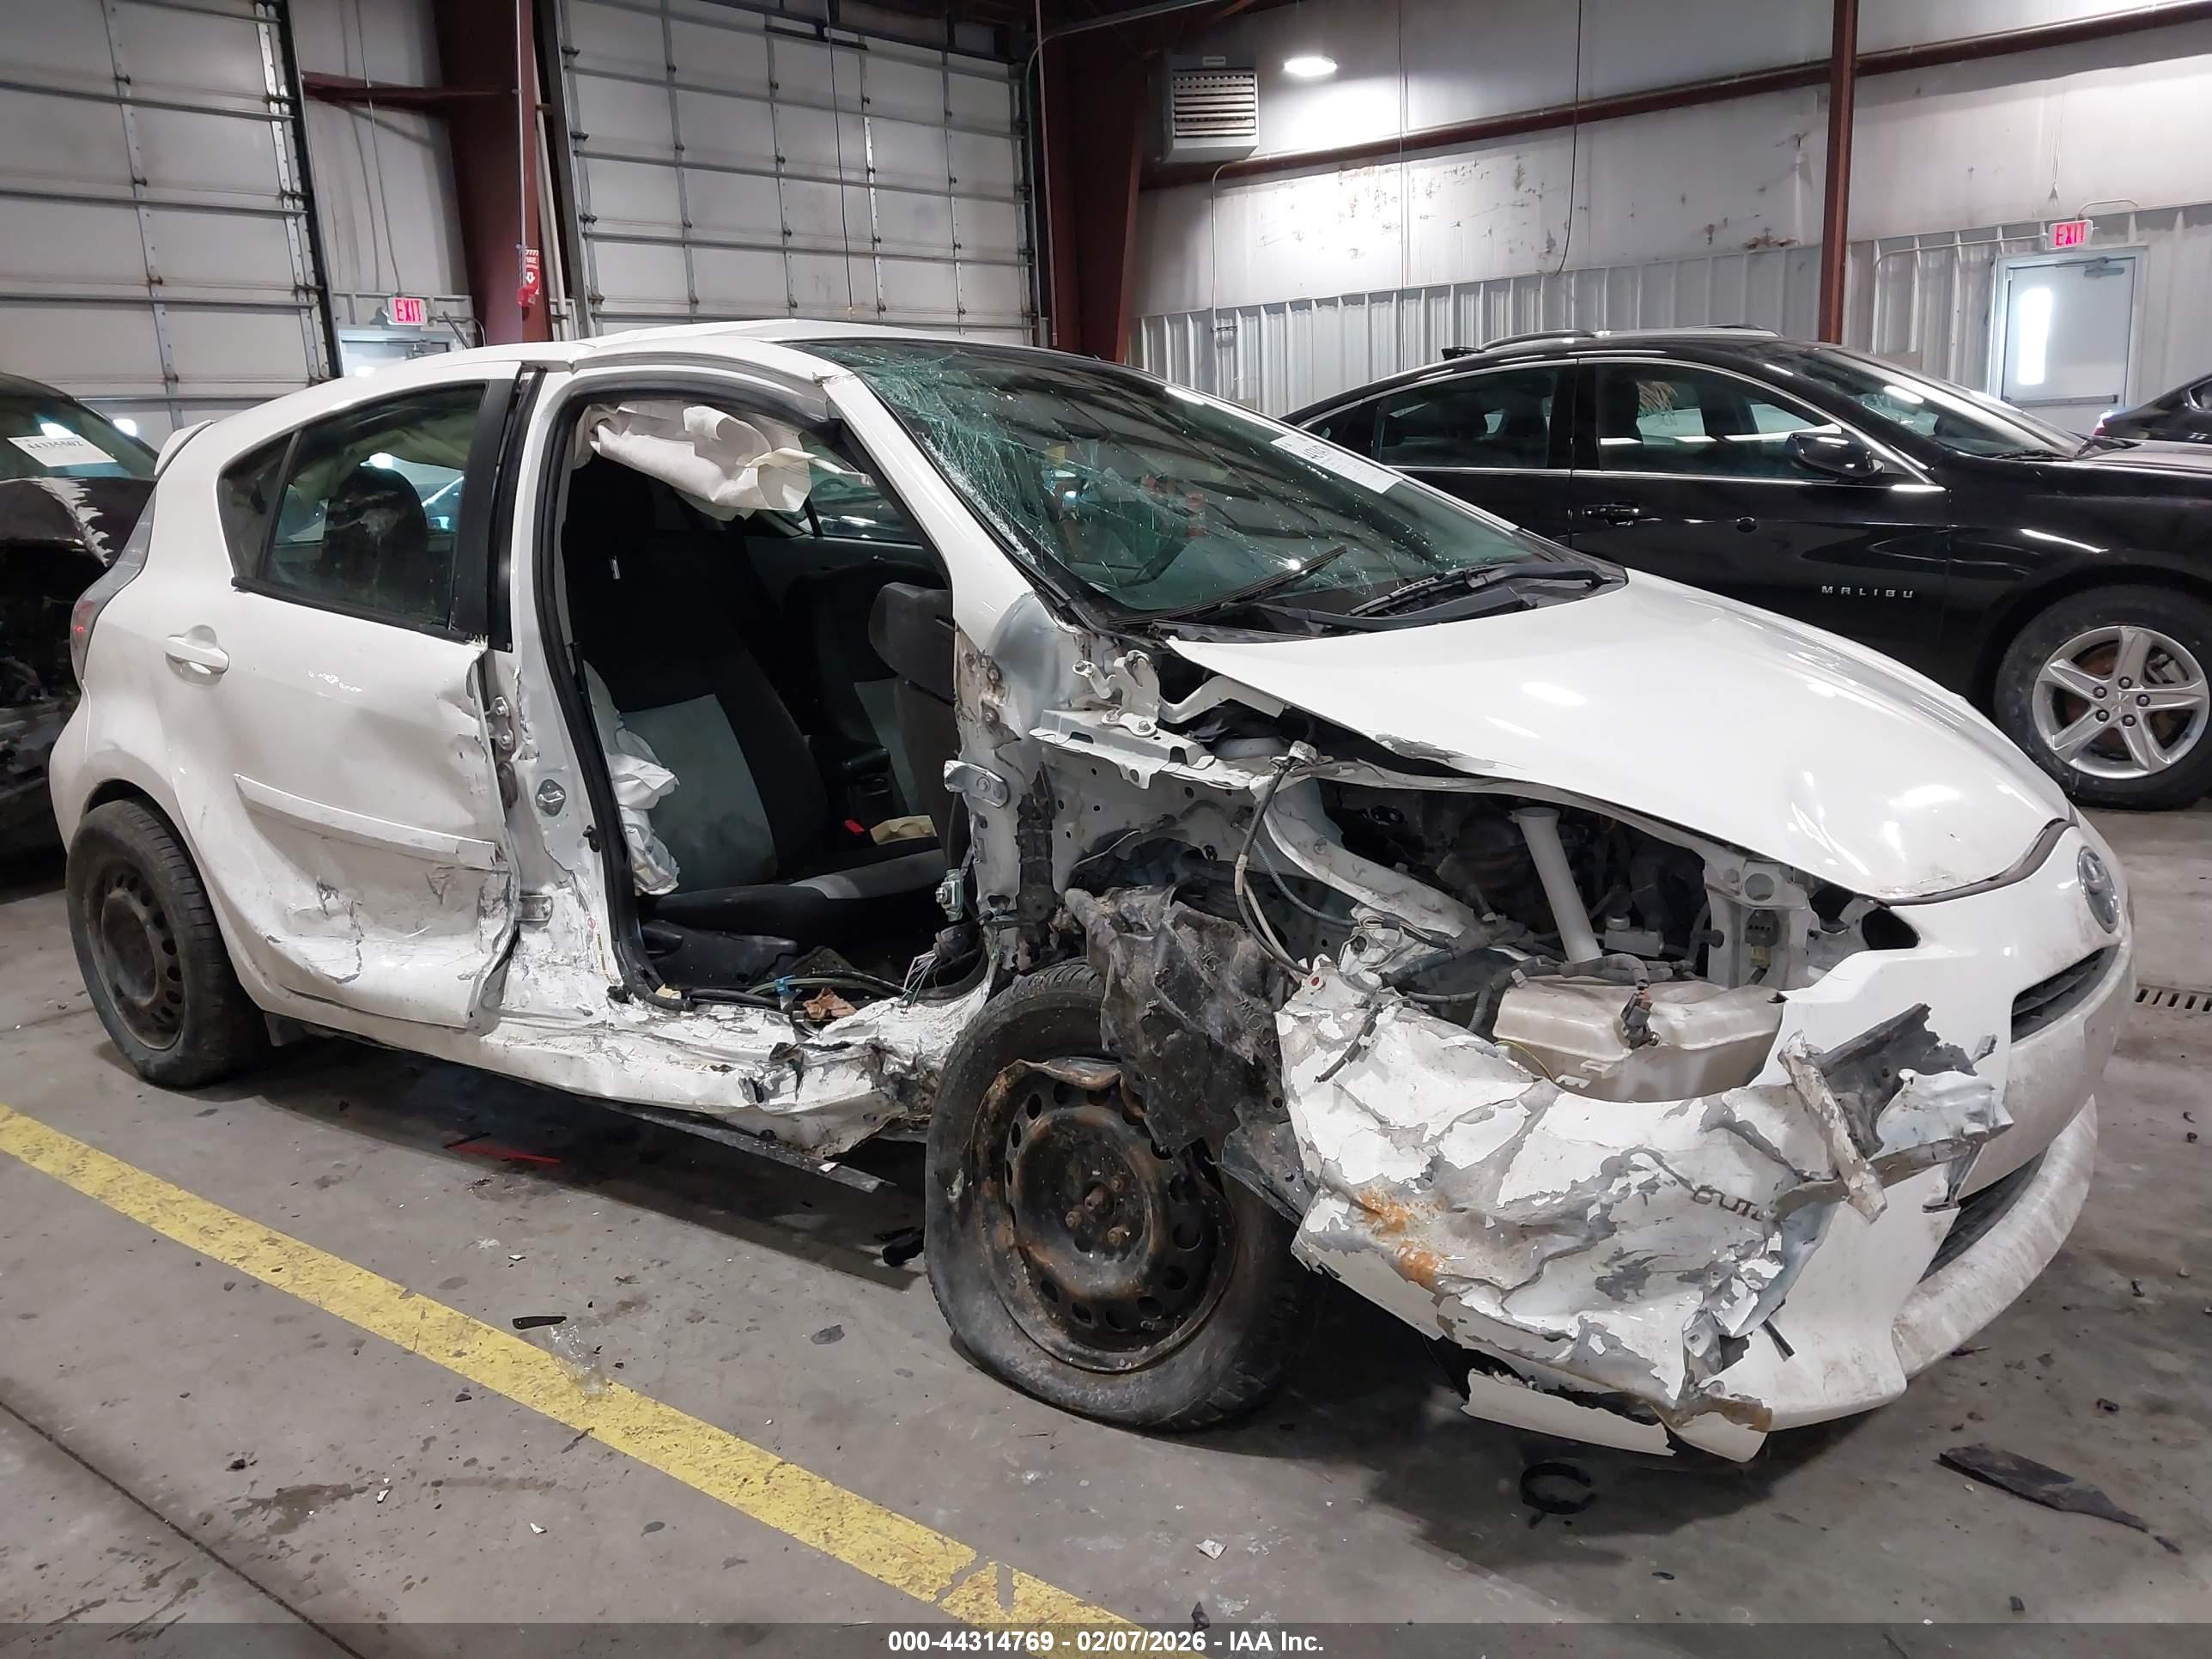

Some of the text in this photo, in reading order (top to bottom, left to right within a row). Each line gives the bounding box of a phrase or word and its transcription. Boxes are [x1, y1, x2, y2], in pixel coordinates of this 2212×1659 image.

[2056, 222, 2087, 246] EXIT
[395, 299, 421, 322] EXIT
[1821, 585, 1914, 599] MALIBU
